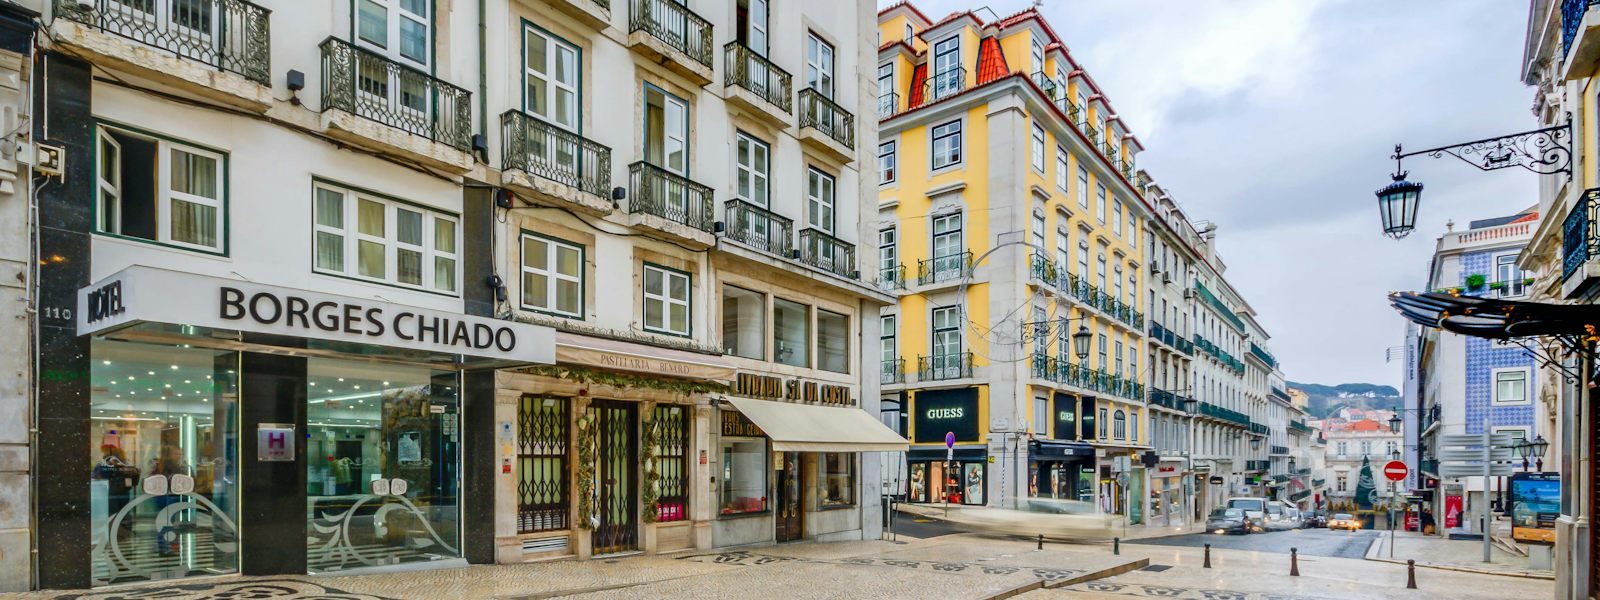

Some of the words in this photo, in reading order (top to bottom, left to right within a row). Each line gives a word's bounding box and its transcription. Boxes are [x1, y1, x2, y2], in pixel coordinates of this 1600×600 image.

[87, 280, 126, 324] HOTEL
[44, 306, 72, 320] 110
[220, 286, 385, 337] BORGES
[393, 312, 516, 352] CHIADO
[600, 354, 650, 370] PASTELARIA
[927, 408, 963, 419] GUESS
[268, 431, 285, 449] H
